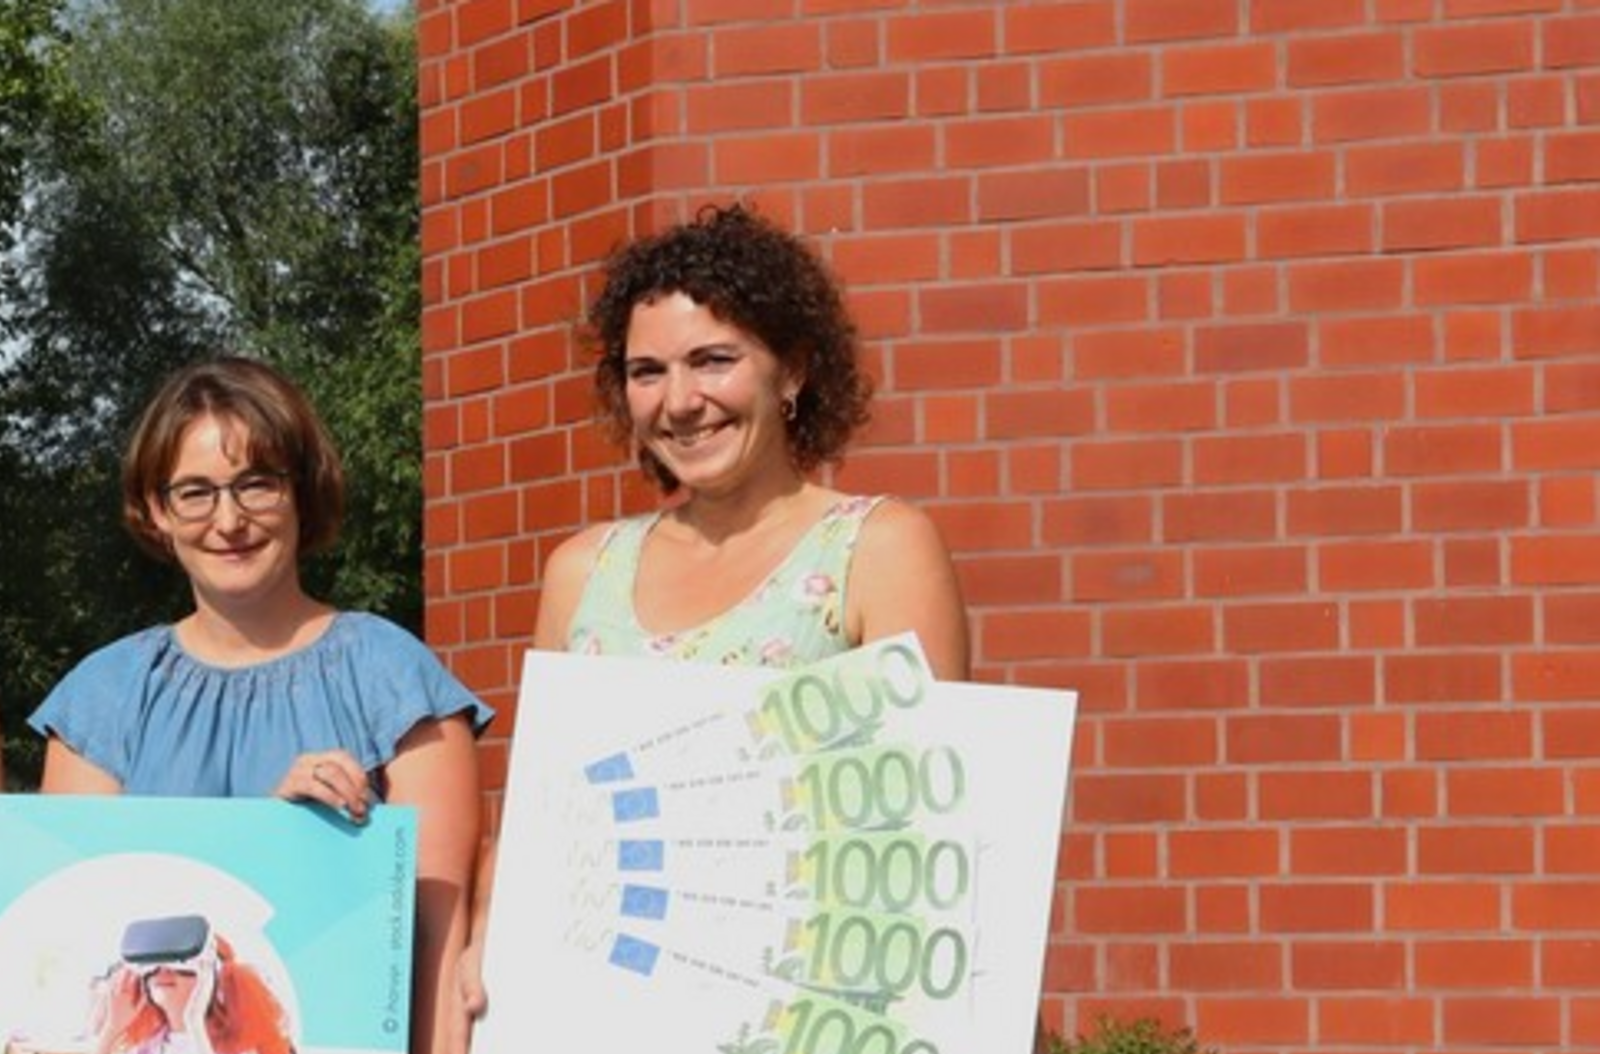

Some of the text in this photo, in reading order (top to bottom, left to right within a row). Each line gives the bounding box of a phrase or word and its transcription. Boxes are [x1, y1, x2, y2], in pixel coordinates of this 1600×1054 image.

[761, 644, 925, 754] 1000
[798, 746, 965, 830] 1000
[804, 839, 969, 912] 1000
[805, 912, 967, 1000] 1000
